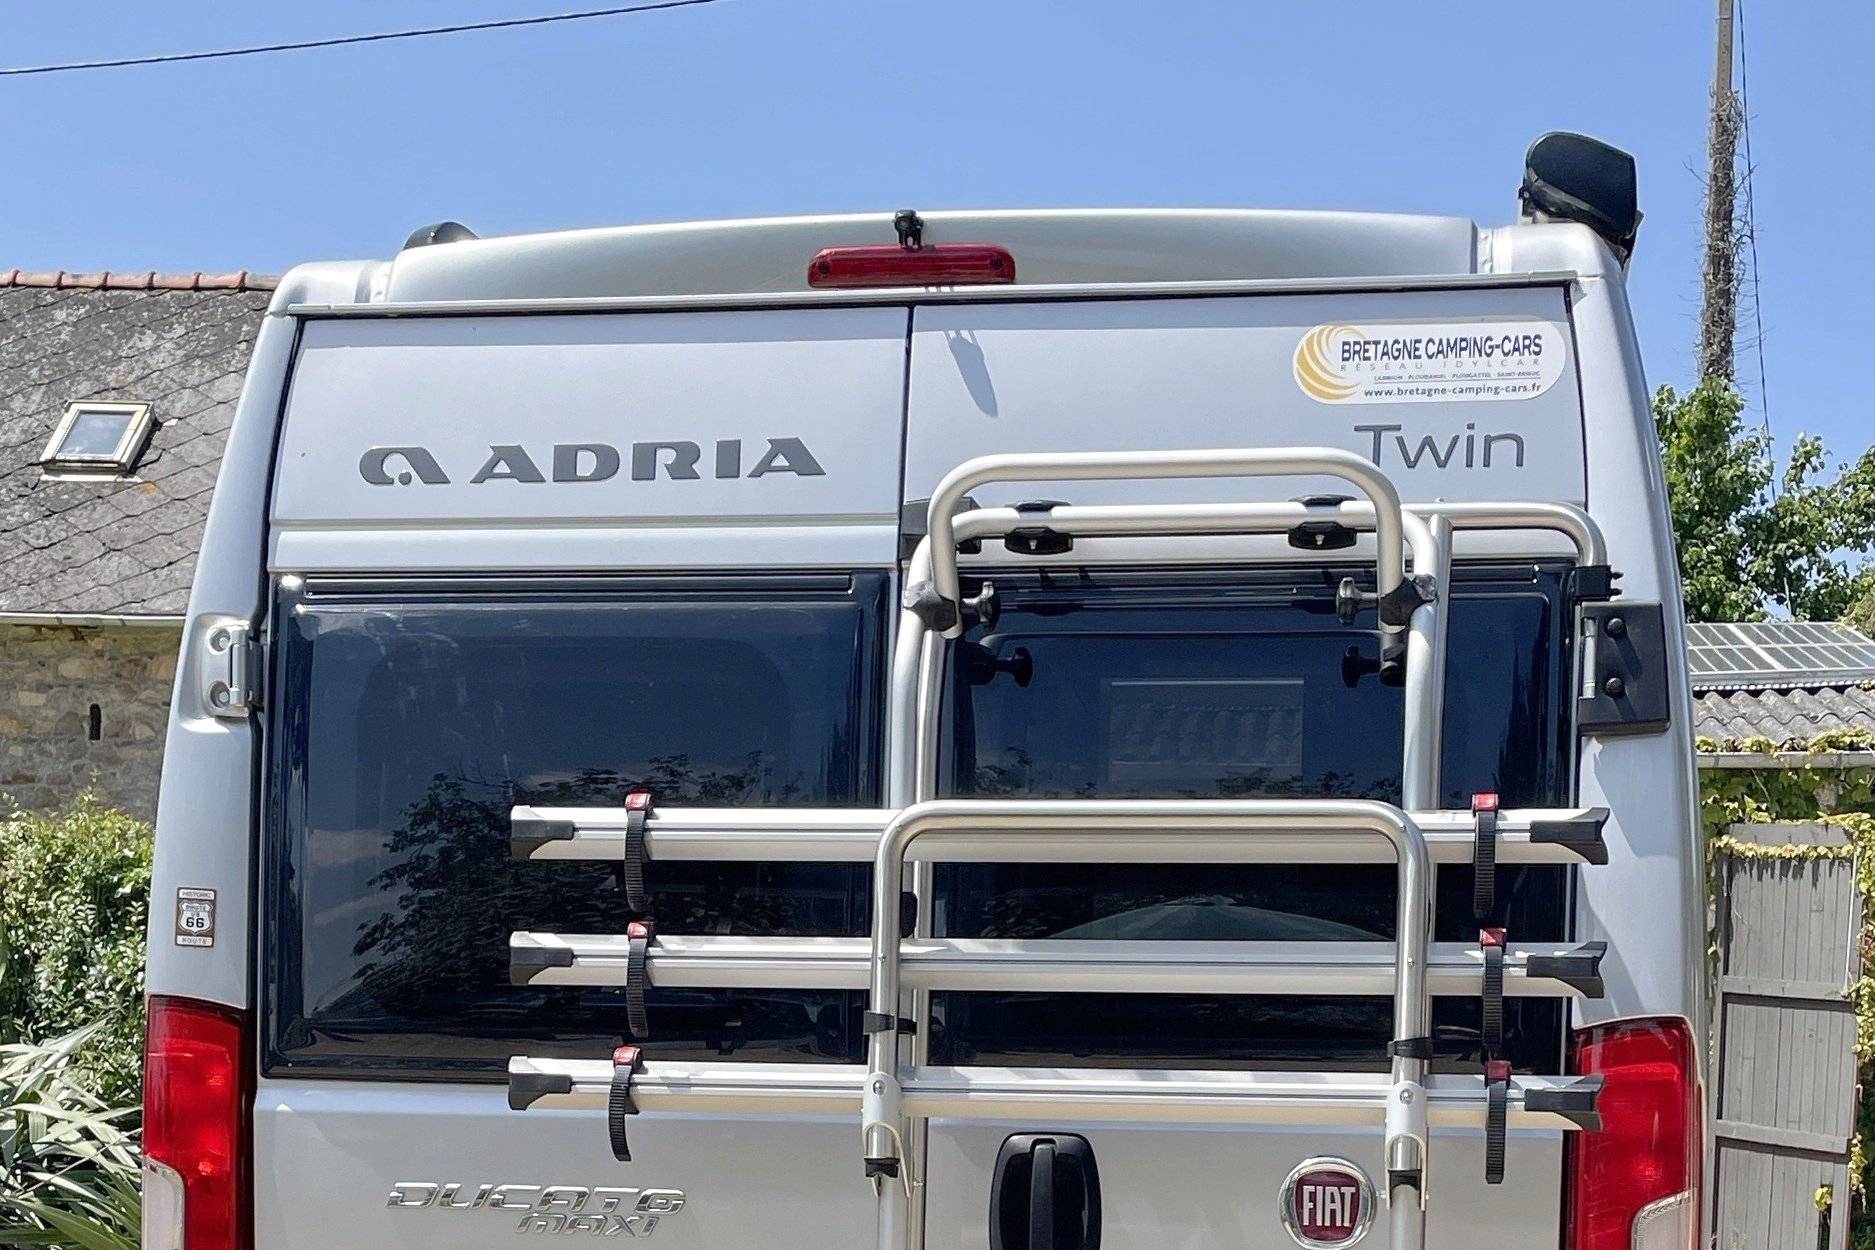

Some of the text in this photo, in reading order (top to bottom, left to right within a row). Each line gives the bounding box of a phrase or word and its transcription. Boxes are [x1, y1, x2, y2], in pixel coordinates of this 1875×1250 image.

[1341, 334, 1542, 361] BRETAGNE CAMPING-CARS
[1364, 382, 1541, 397] www.bretagne-camping-cars.fr
[469, 437, 827, 484] ADRIA
[1353, 422, 1525, 471] Twin
[185, 916, 204, 928] 66
[386, 1182, 687, 1215] DUCATO
[1302, 1185, 1356, 1227] FIAT
[513, 1212, 660, 1238] MAXI
